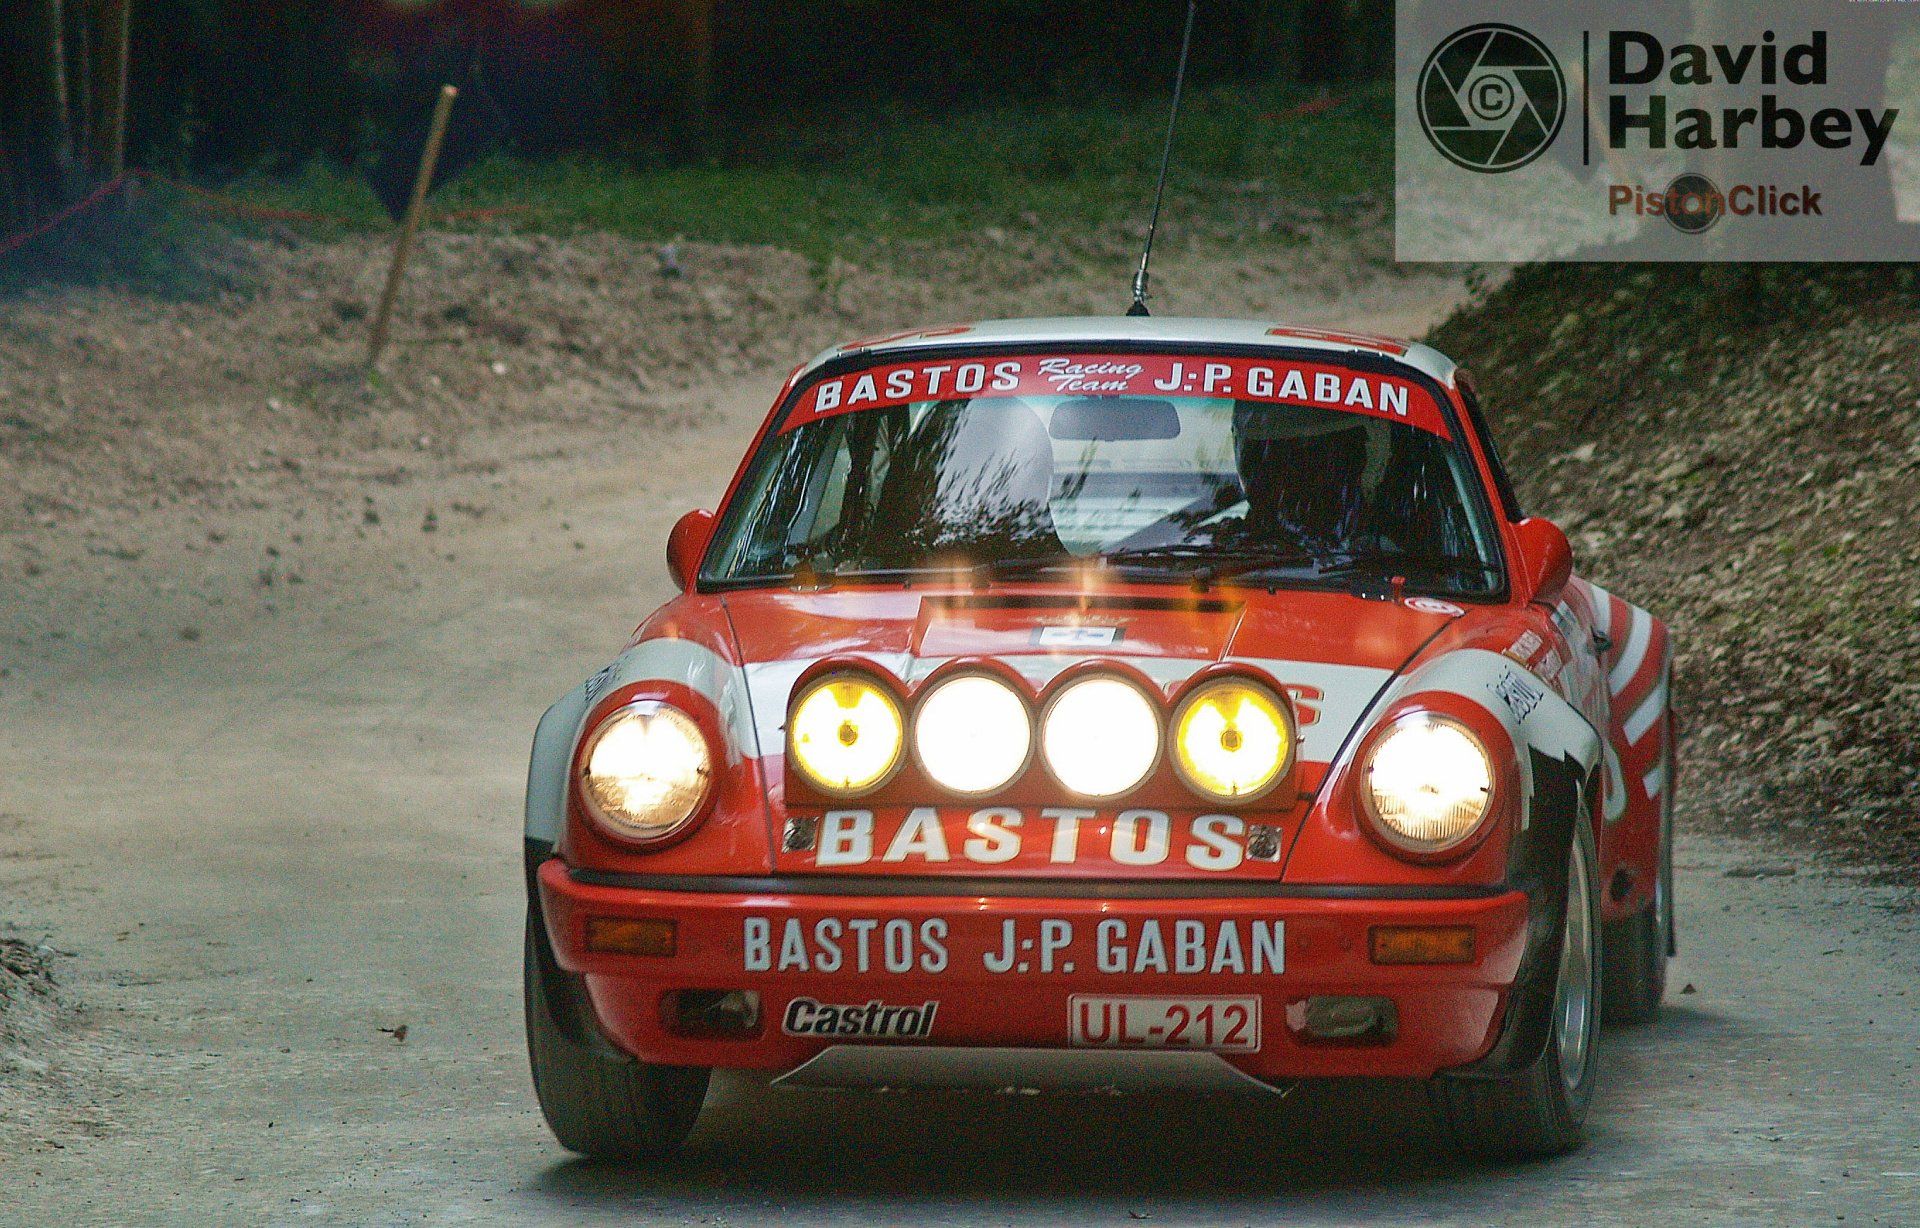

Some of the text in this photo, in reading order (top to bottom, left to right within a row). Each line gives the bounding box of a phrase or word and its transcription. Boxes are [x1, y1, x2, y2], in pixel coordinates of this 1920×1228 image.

[814, 361, 1022, 414] BASTOS
[1247, 368, 1409, 416] GABAN
[1038, 358, 1144, 380] Racing
[1048, 374, 1129, 392] Team
[815, 807, 1247, 871] BASTOS
[743, 917, 949, 973] BASTOS
[1096, 919, 1286, 974] GABAN
[784, 998, 938, 1036] Castrol
[1080, 1002, 1249, 1046] UL-212
